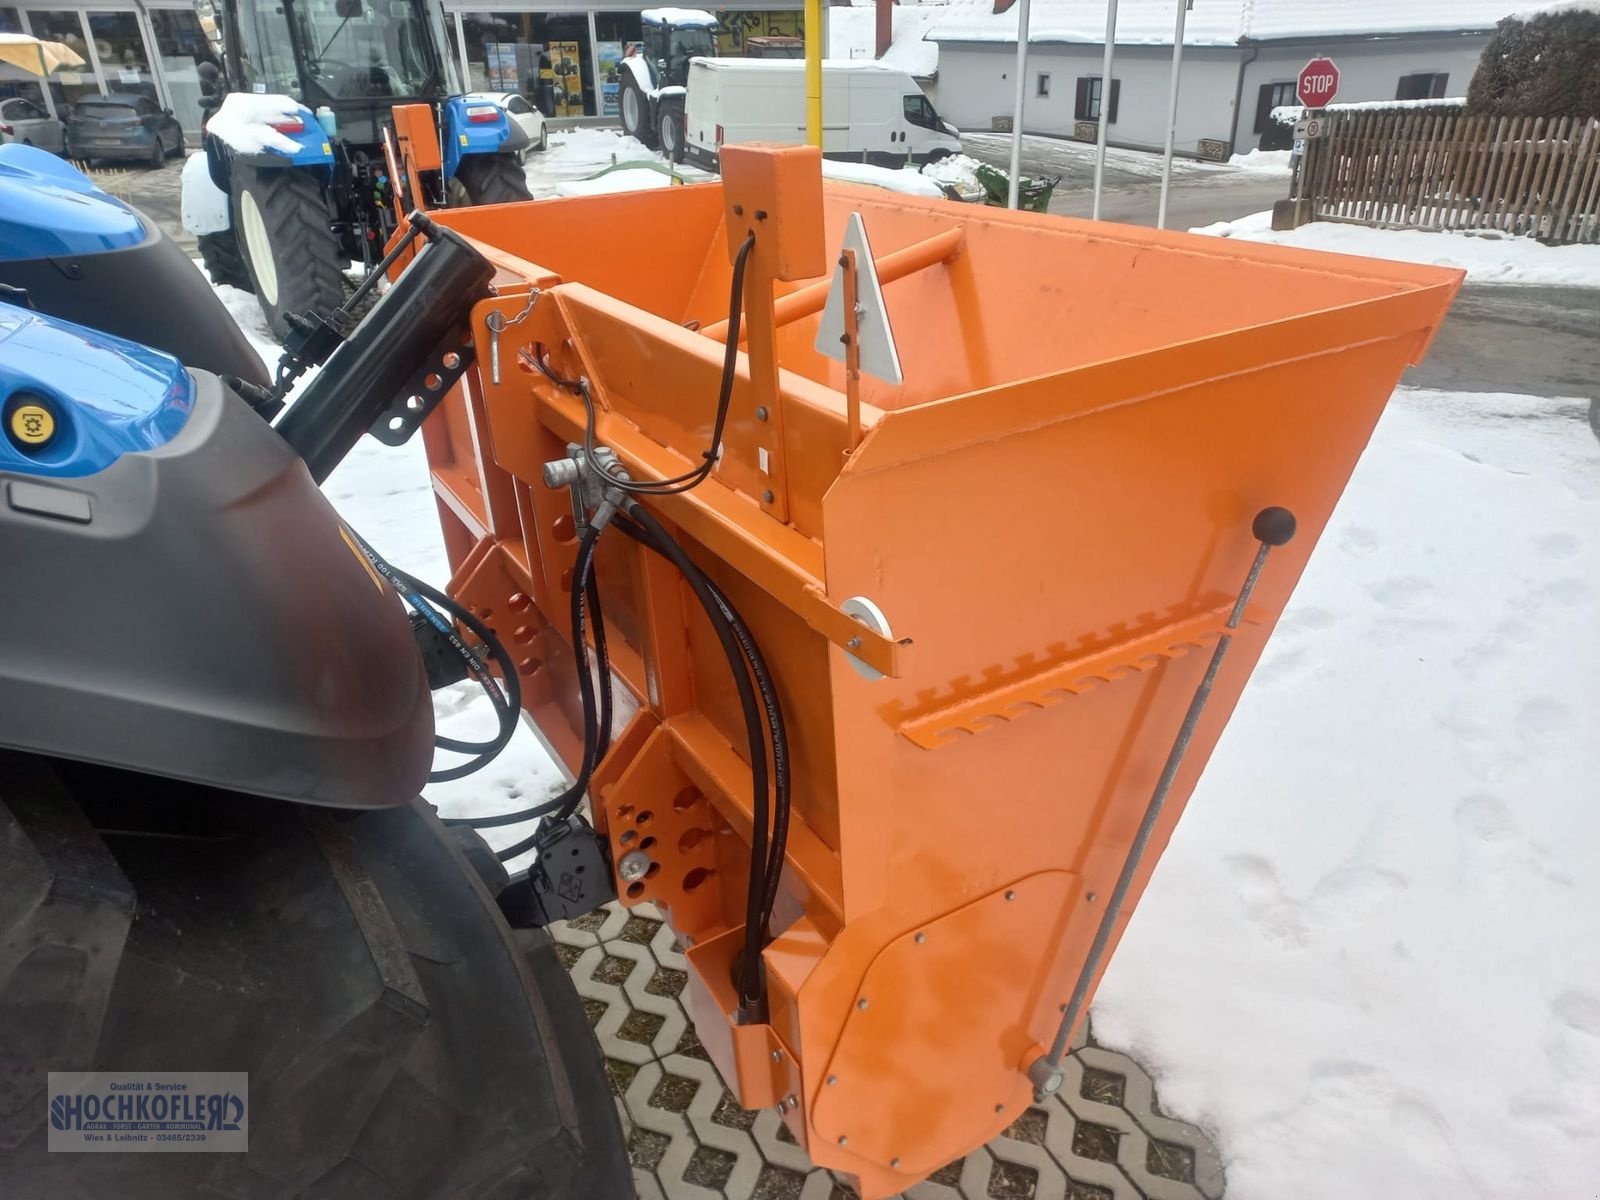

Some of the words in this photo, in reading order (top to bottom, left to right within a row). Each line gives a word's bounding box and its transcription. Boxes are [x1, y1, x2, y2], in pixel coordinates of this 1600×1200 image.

[1303, 74, 1334, 94] STOP
[376, 562, 391, 577] 100
[389, 575, 408, 592] SAE
[447, 634, 462, 648] 853
[459, 646, 471, 659] EN
[467, 657, 480, 671] DIN
